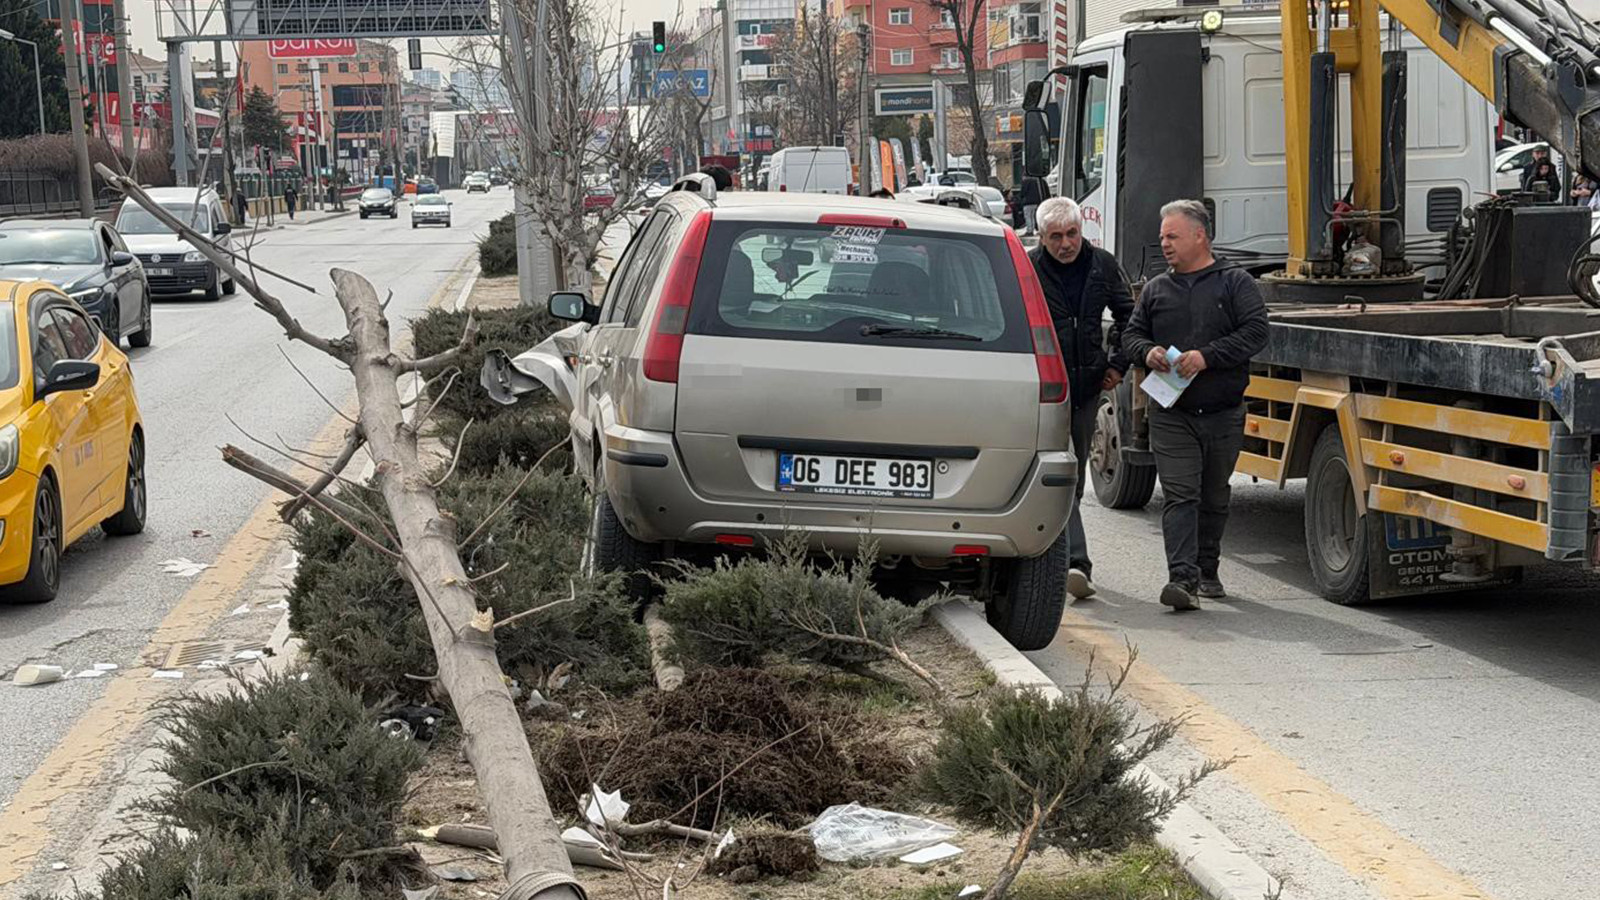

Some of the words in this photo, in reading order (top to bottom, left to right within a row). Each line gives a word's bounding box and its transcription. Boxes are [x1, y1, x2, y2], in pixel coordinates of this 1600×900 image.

[793, 457, 820, 483] 06
[835, 459, 876, 486] DEE
[888, 462, 929, 488] 983
[1398, 565, 1442, 576] GENEL
